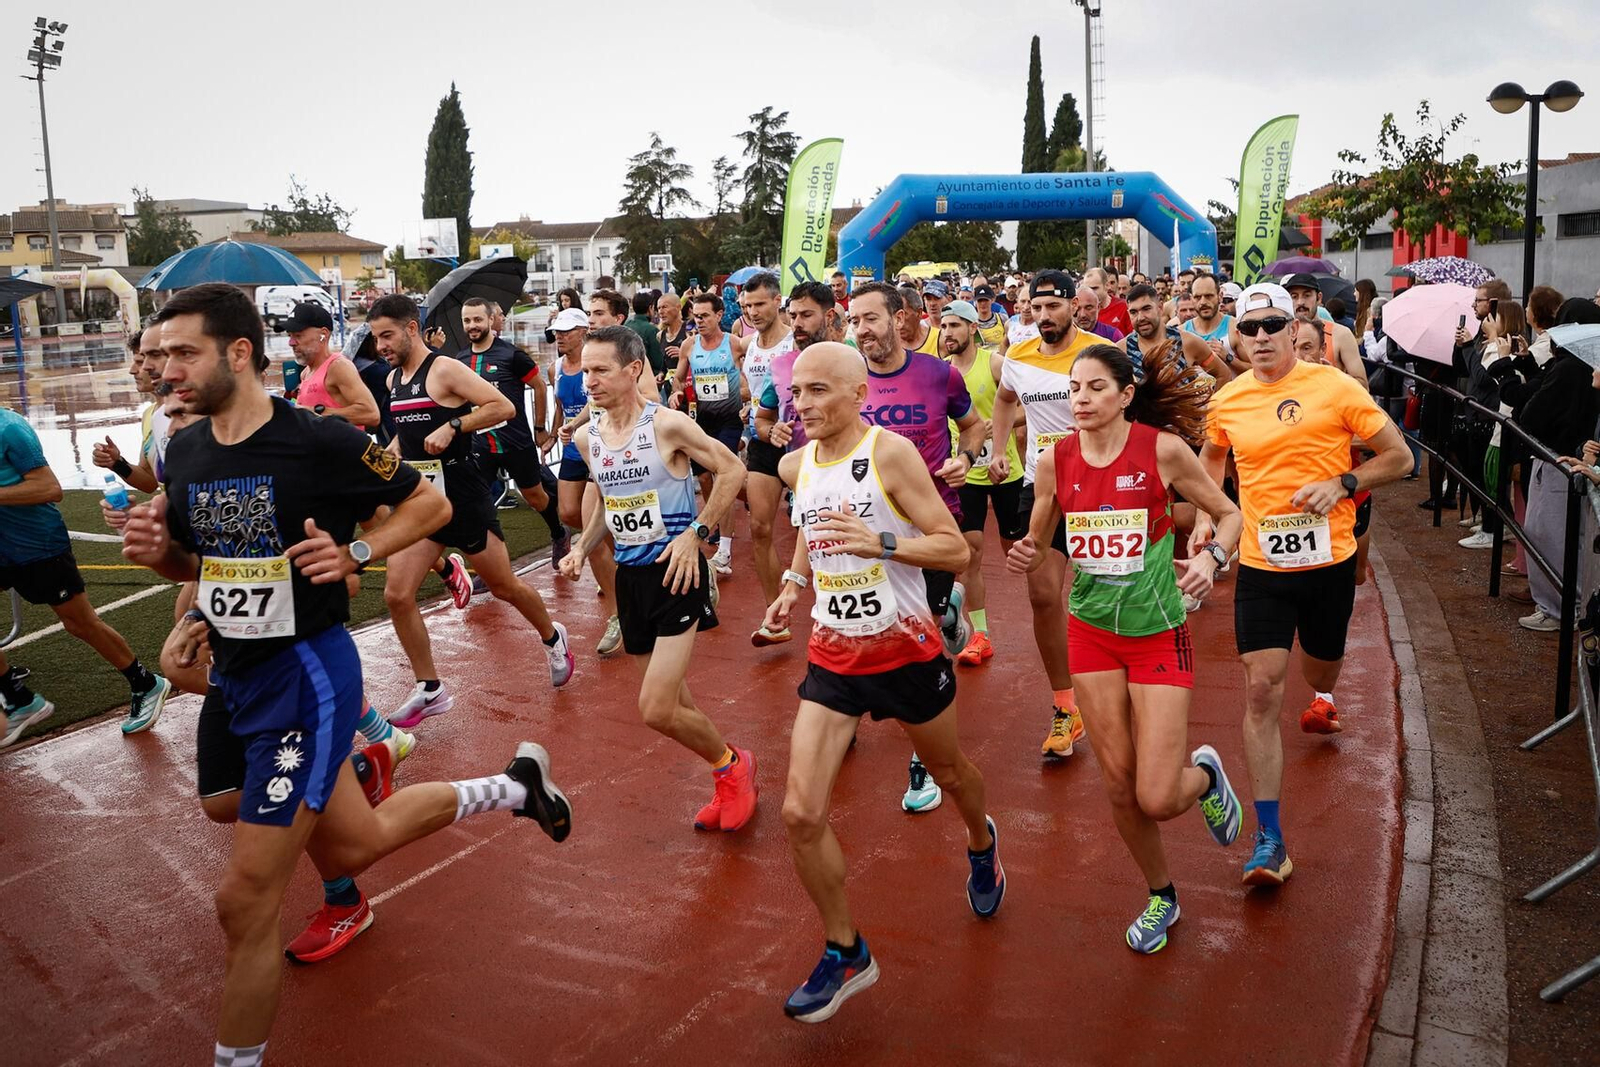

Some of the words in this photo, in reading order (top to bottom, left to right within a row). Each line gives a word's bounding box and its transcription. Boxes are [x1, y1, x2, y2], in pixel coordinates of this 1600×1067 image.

[936, 179, 1031, 195] Ayuntamiento
[1034, 179, 1050, 190] de
[1054, 177, 1101, 189] Santa
[1106, 175, 1125, 187] Fe
[1254, 146, 1275, 239] Diputación
[801, 165, 821, 252] Diputación
[1008, 200, 1020, 209] de
[1022, 199, 1066, 211] Deporte
[1068, 200, 1075, 210] y
[1078, 196, 1108, 207] Salud
[814, 234, 823, 253] de
[702, 384, 718, 395] 61
[1021, 389, 1071, 405] Continental
[597, 465, 651, 483] MARACENA
[612, 509, 654, 533] 964
[1075, 516, 1087, 528] 38
[1087, 518, 1129, 528] FONDO
[1265, 520, 1276, 529] 38
[1275, 518, 1313, 529] FONDO
[1069, 533, 1144, 559] 2052
[1268, 530, 1317, 555] 281
[829, 576, 869, 588] FONDO
[210, 586, 275, 617] 627
[828, 590, 882, 620] 425
